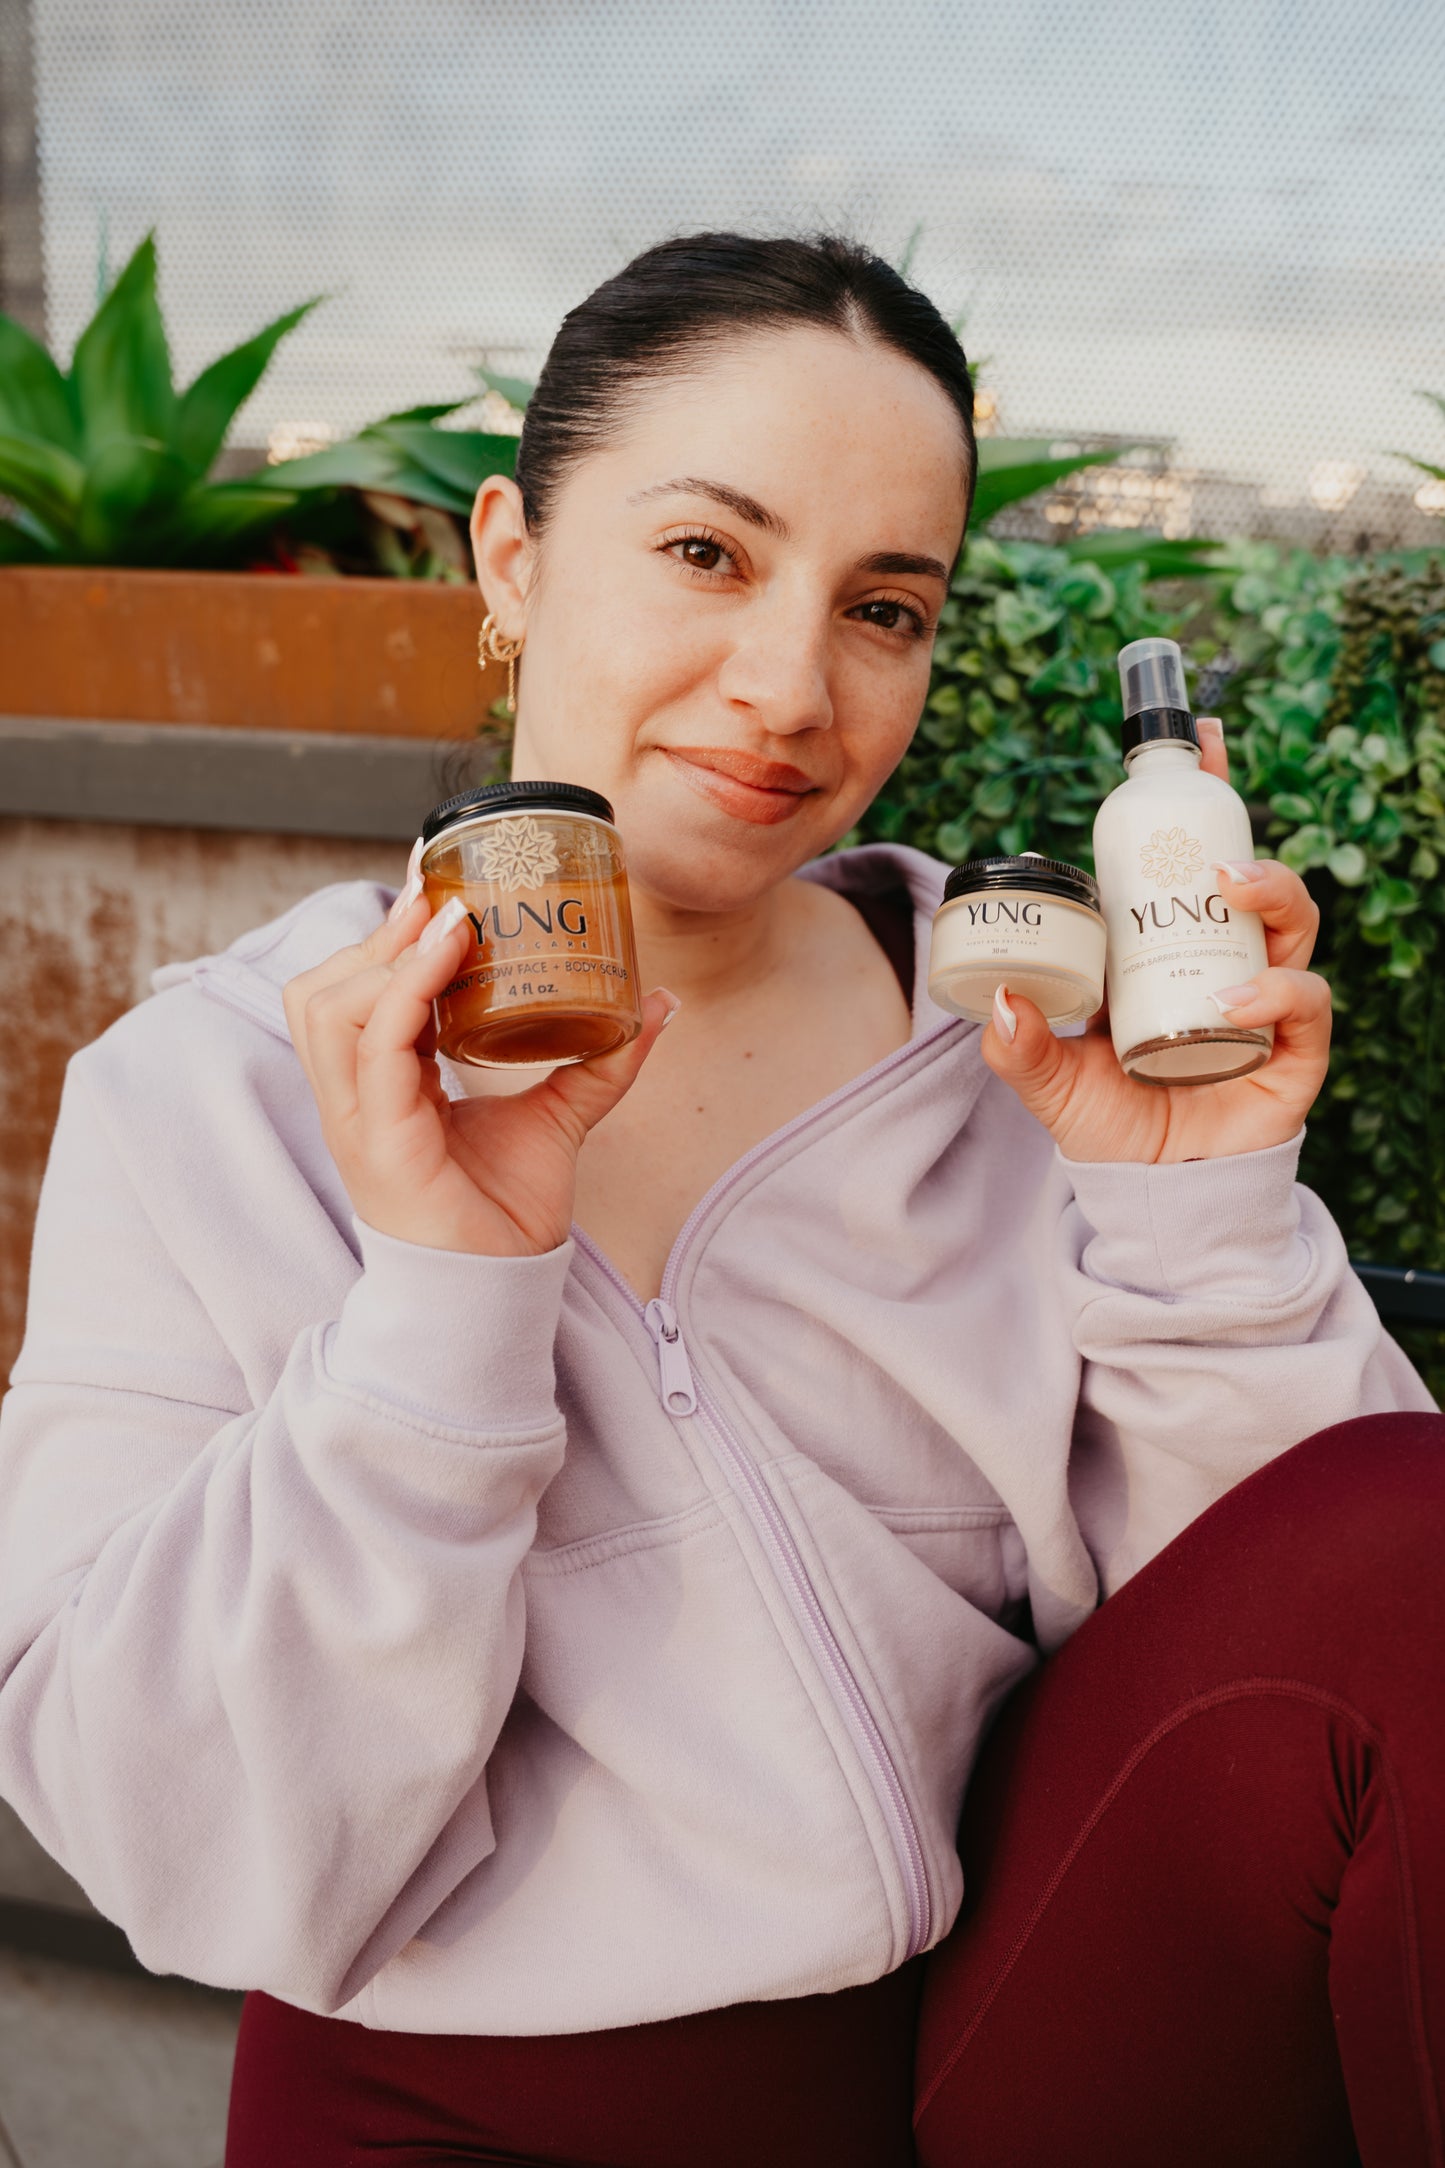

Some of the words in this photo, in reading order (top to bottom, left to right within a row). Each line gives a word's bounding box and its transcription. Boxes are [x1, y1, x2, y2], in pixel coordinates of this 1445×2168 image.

[467, 900, 587, 945] YUNG
[967, 901, 1041, 926] YUNG
[1129, 894, 1230, 934] YUNG
[1122, 961, 1146, 976] HYDRA
[1147, 951, 1182, 966] BARRIER
[1183, 948, 1231, 959] CLEANSING
[1232, 949, 1249, 960] MILK
[1169, 970, 1176, 978] 4
[1178, 968, 1187, 977] fl
[440, 975, 474, 999] NSTANT
[478, 966, 513, 984] GLOW
[517, 961, 548, 974] FACE
[553, 963, 560, 971] +
[565, 961, 597, 973] BODY
[600, 963, 628, 980] SCRUB
[509, 985, 518, 997] 4
[522, 983, 533, 995] fl
[537, 984, 559, 993] oz.
